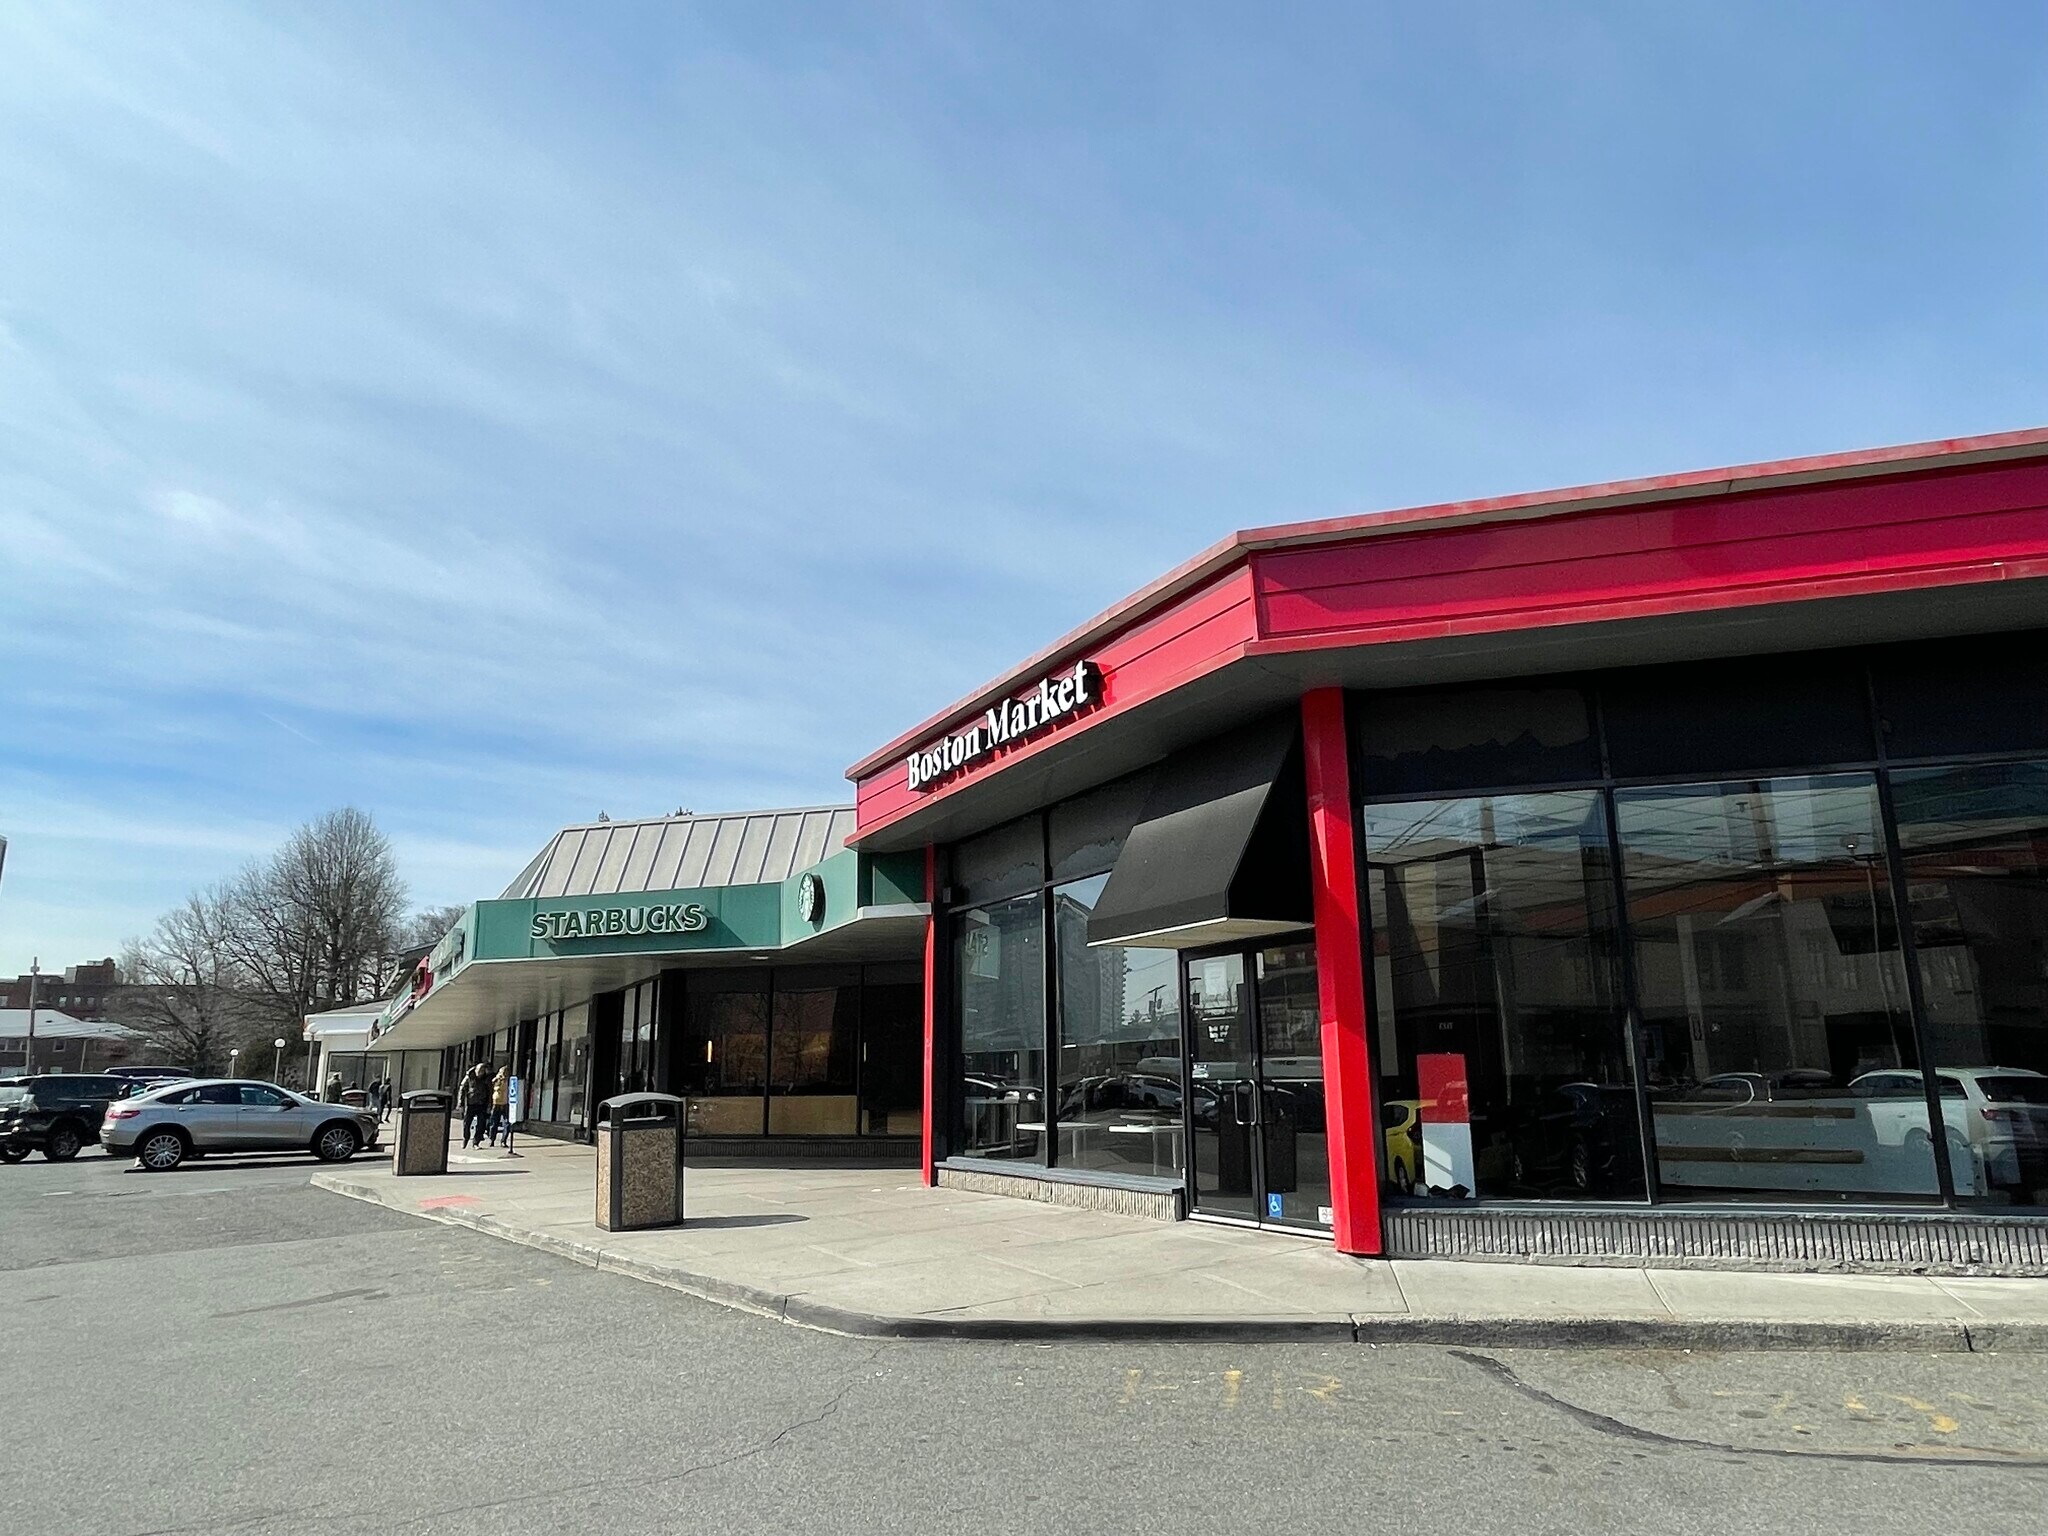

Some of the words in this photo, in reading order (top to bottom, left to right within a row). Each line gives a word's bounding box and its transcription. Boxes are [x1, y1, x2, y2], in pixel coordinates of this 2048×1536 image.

[906, 726, 981, 791] Boston
[985, 660, 1088, 750] Market
[531, 903, 708, 940] STARBUCKS
